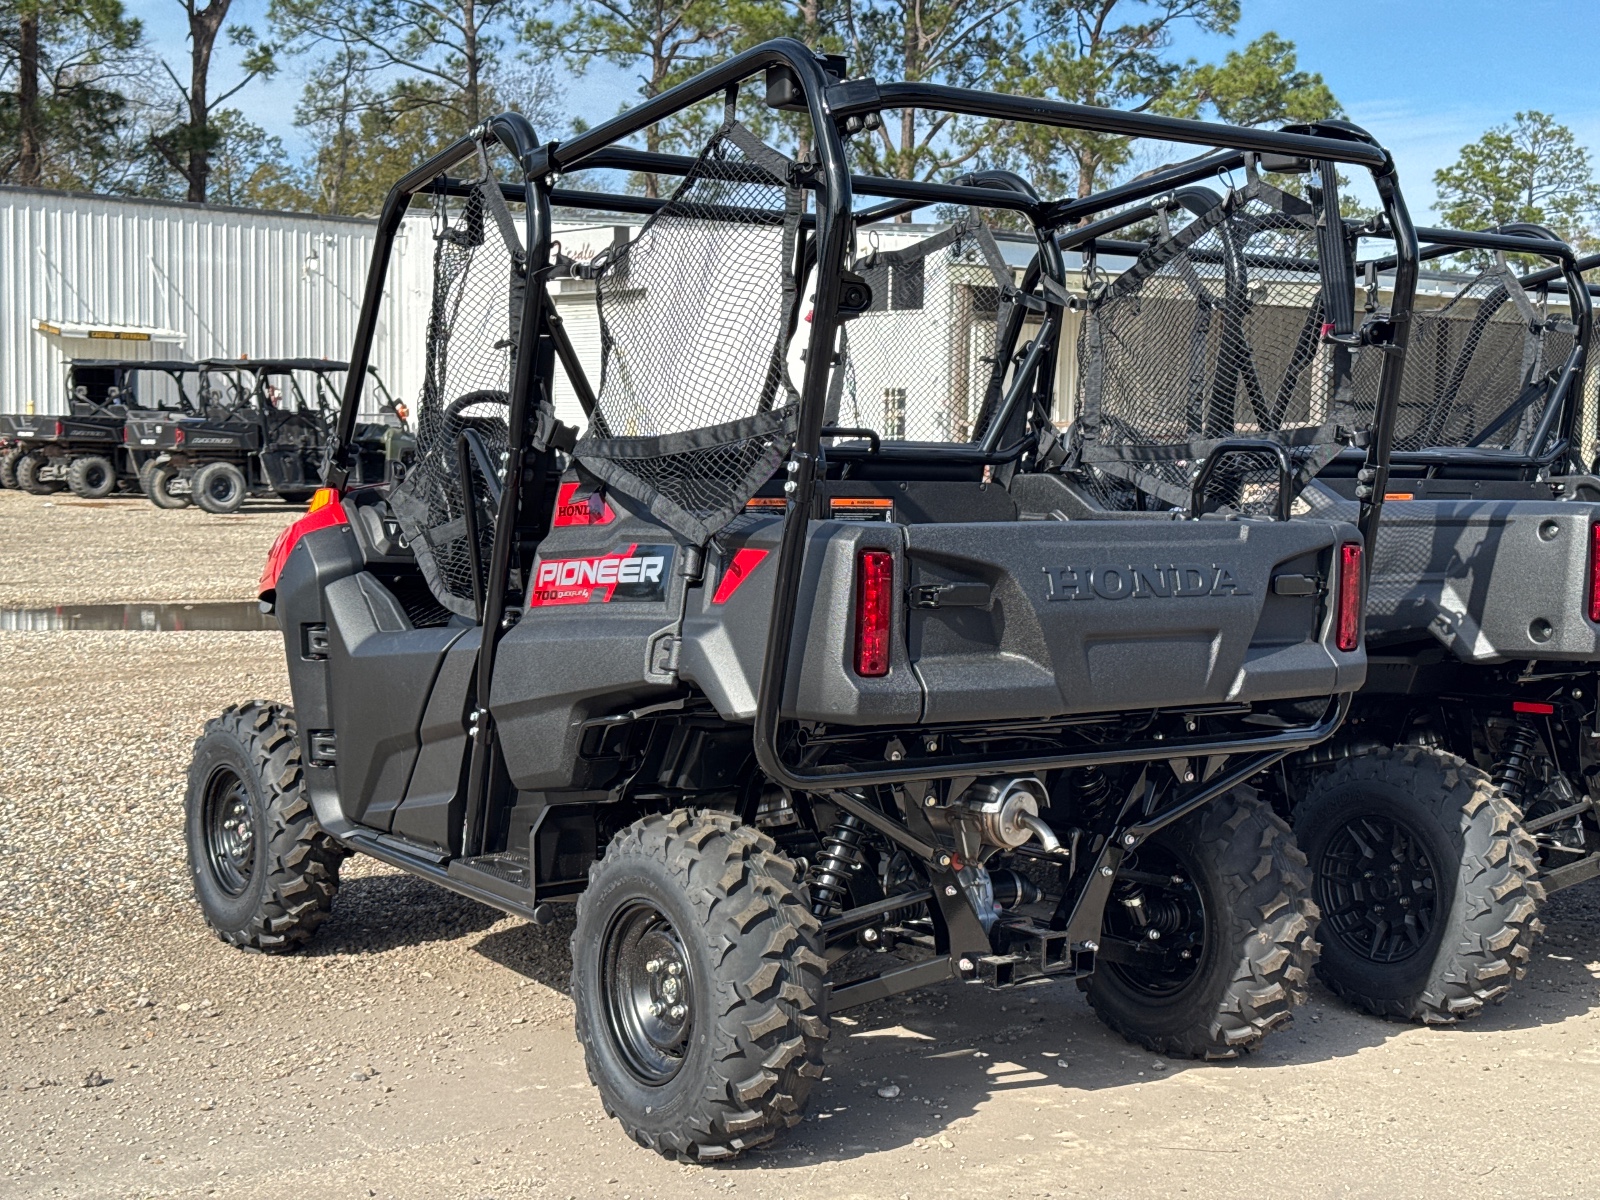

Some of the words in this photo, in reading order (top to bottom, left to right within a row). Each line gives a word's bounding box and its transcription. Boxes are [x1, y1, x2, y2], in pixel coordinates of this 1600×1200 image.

[538, 556, 664, 587] PIONEER
[1041, 563, 1253, 600] HONDA
[534, 590, 558, 600] 700
